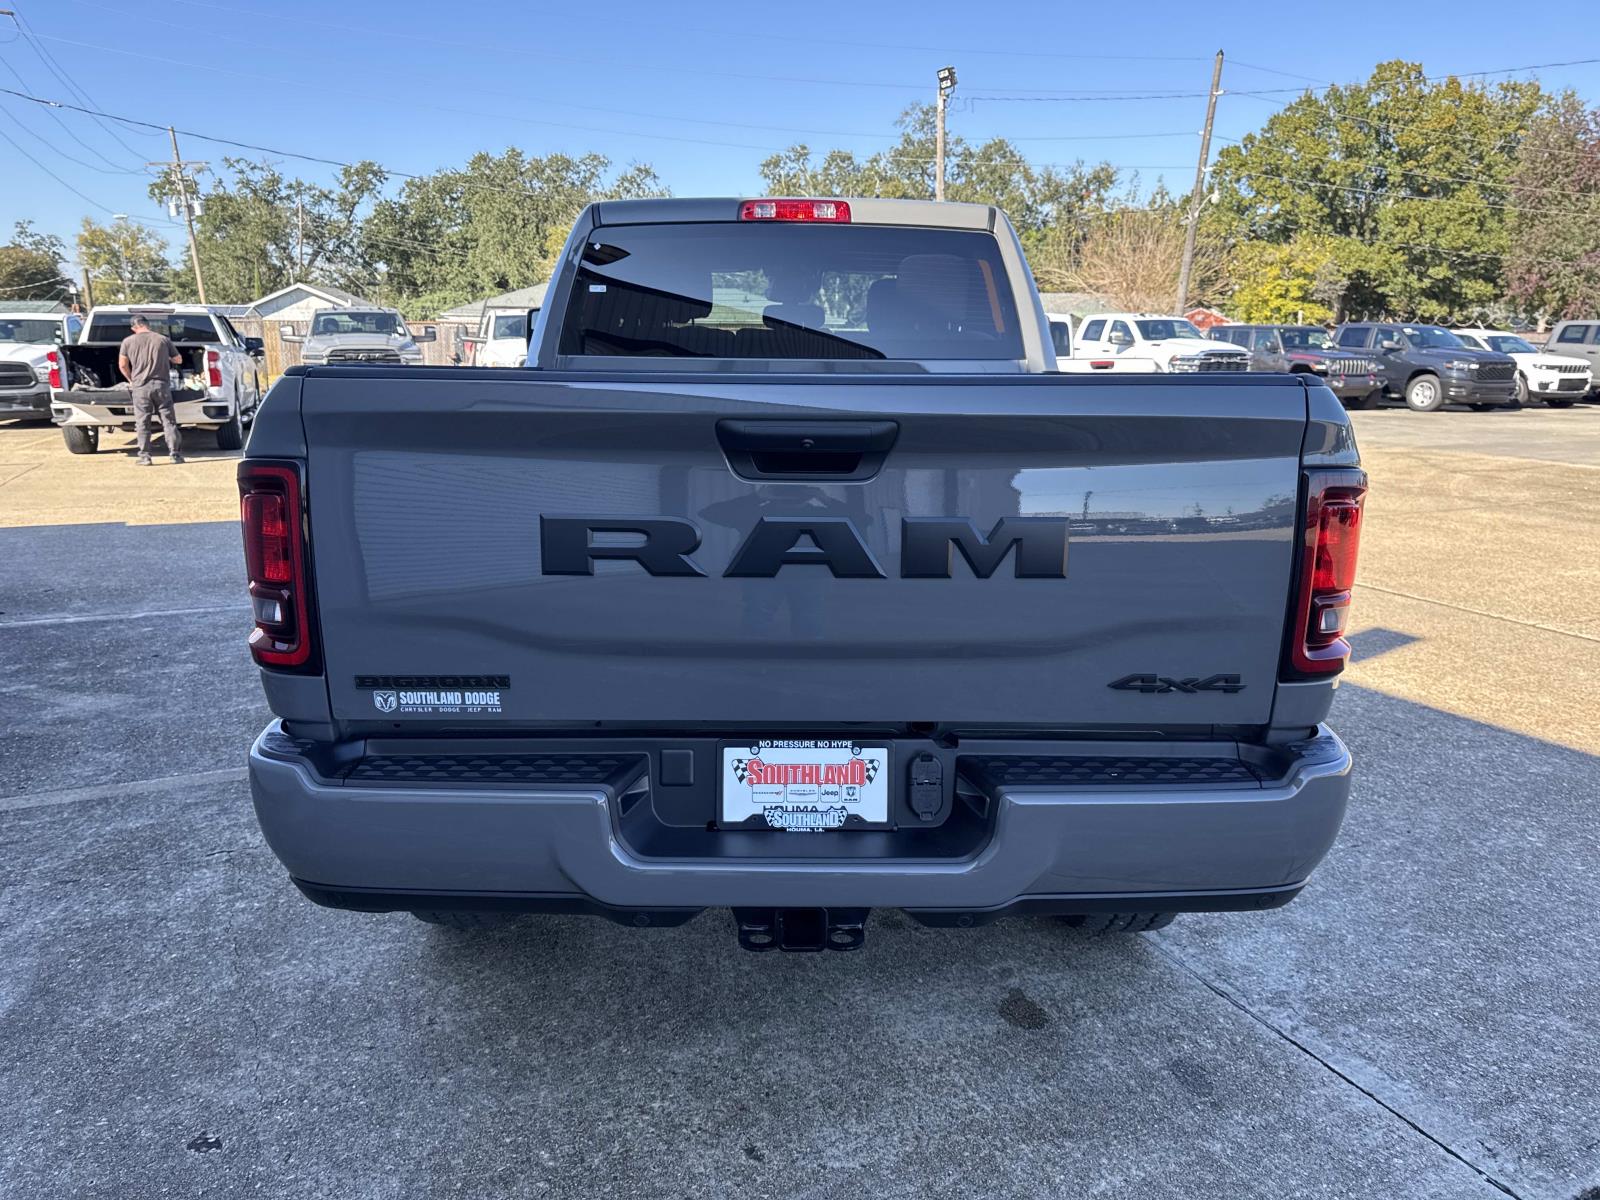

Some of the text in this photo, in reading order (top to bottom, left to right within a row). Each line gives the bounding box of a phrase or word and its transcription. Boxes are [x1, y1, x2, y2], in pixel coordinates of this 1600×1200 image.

[540, 514, 1069, 579] RAM
[399, 692, 501, 705] SOUTHLAND DODGE
[759, 740, 853, 748] NO PRESSURE NO HYPE
[747, 758, 866, 786] SOUTHLAND
[821, 789, 839, 797] Jeep
[773, 811, 839, 826] SOUTHLAND
